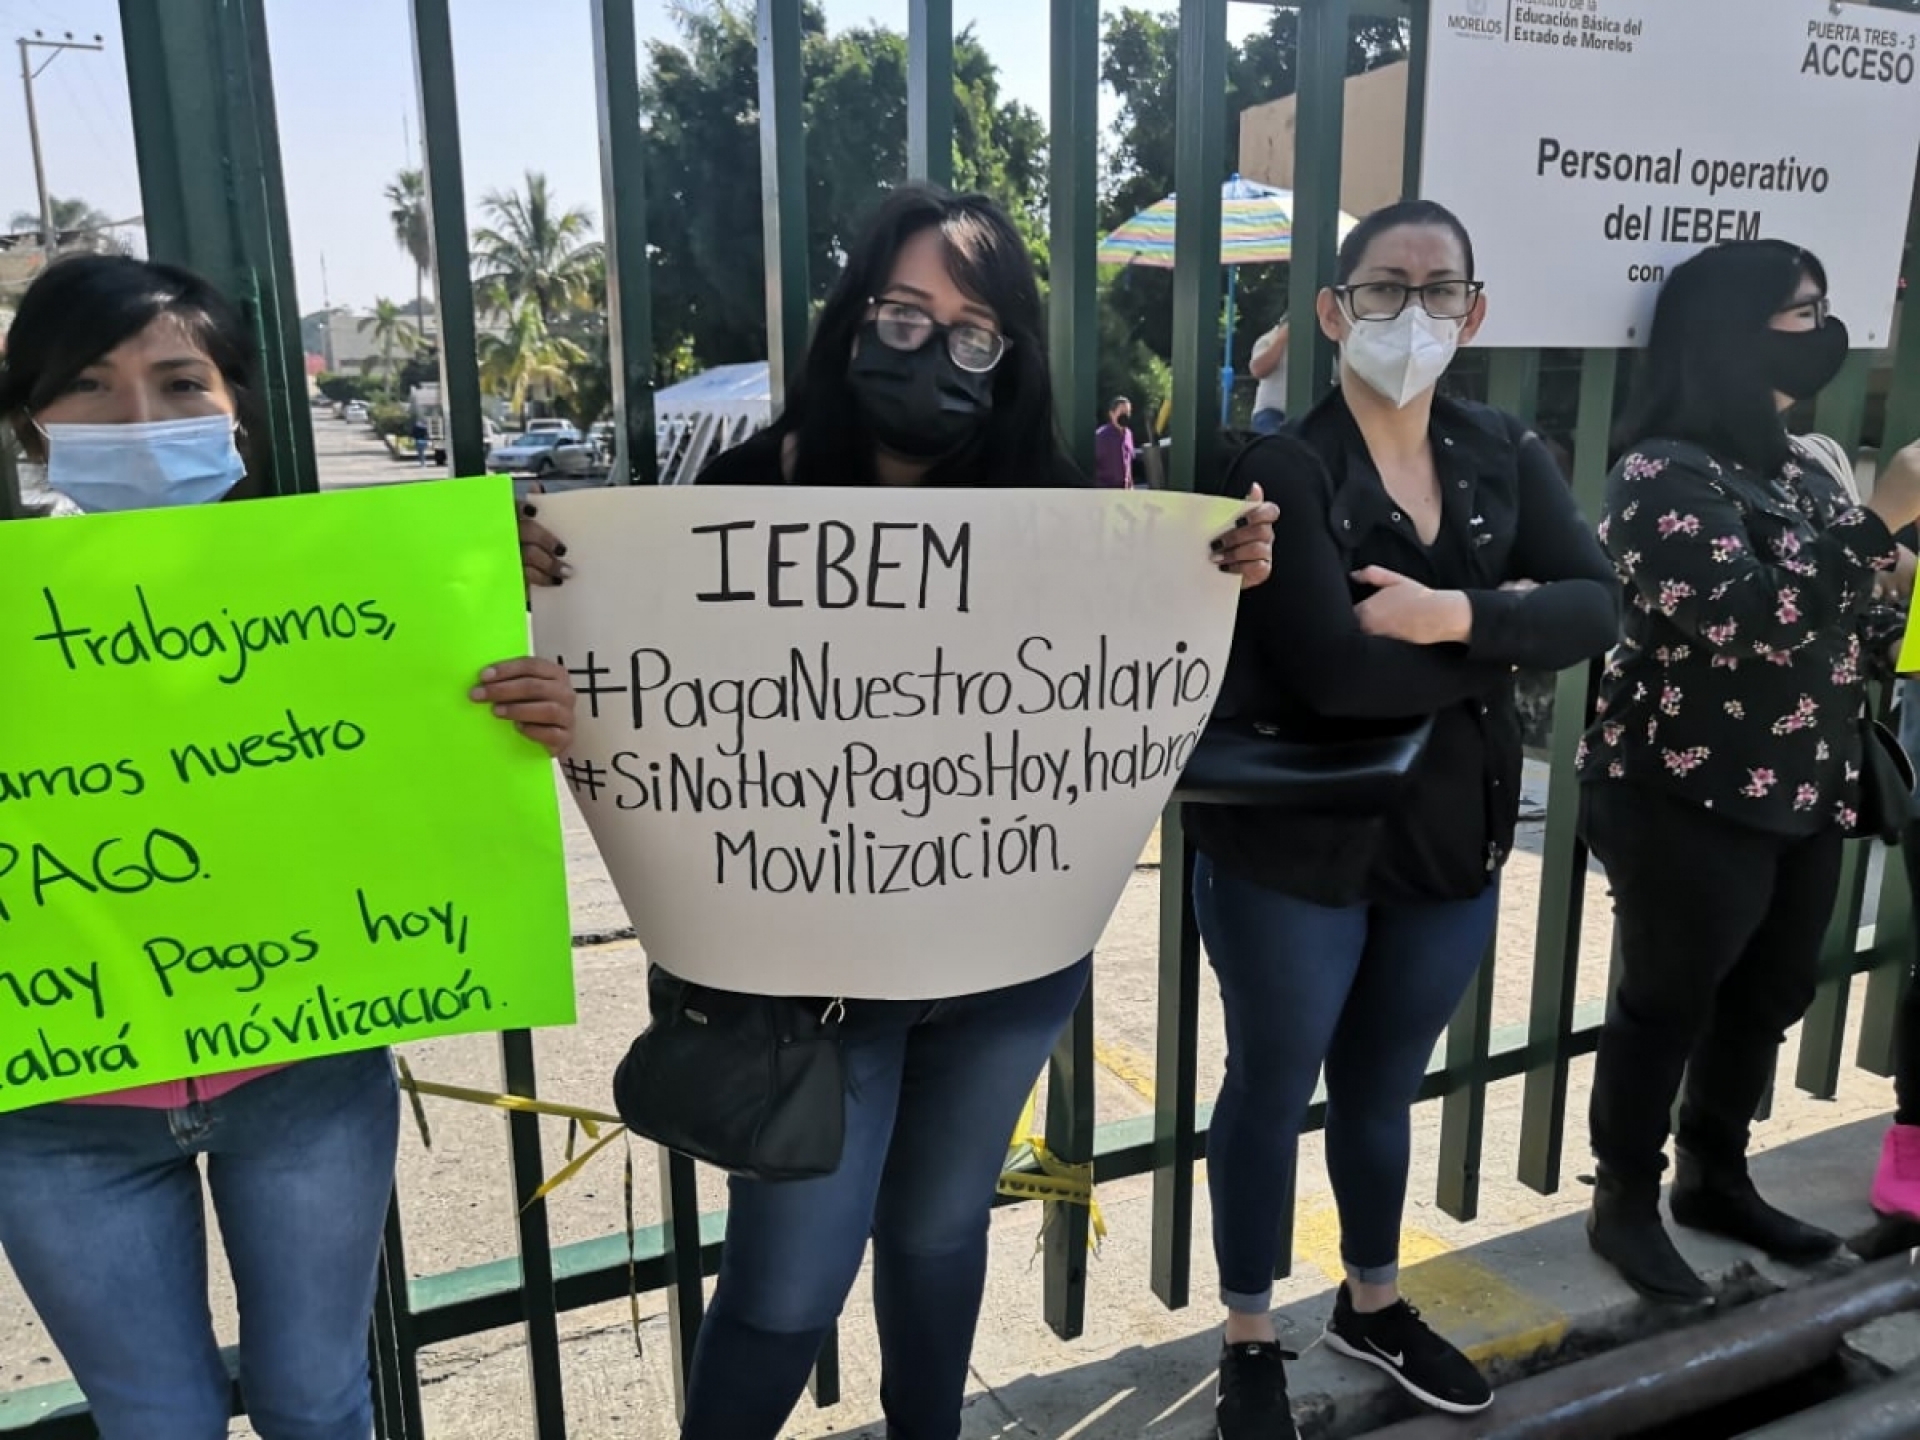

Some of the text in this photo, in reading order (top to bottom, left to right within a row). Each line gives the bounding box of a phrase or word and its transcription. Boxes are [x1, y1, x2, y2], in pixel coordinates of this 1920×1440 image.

[1447, 14, 1502, 35] MORELOS
[1514, 26, 1559, 45] Estado
[1562, 31, 1578, 47] de
[1580, 32, 1633, 53] Morelos
[1515, 8, 1643, 35] Educación Básica del
[1807, 20, 1860, 42] PUERTA
[1864, 27, 1898, 47] TRES
[1801, 41, 1914, 84] ACCESO
[1537, 137, 1830, 196] Personal operativo
[1603, 203, 1761, 244] del IEBEM
[1627, 264, 1665, 282] con
[692, 519, 972, 614] IEBEM
[34, 583, 396, 685] trabajamos,
[170, 709, 366, 783] nuestro
[714, 813, 1071, 894] Movilización.
[357, 888, 468, 954] hoy,
[0, 1022, 139, 1089] abrá
